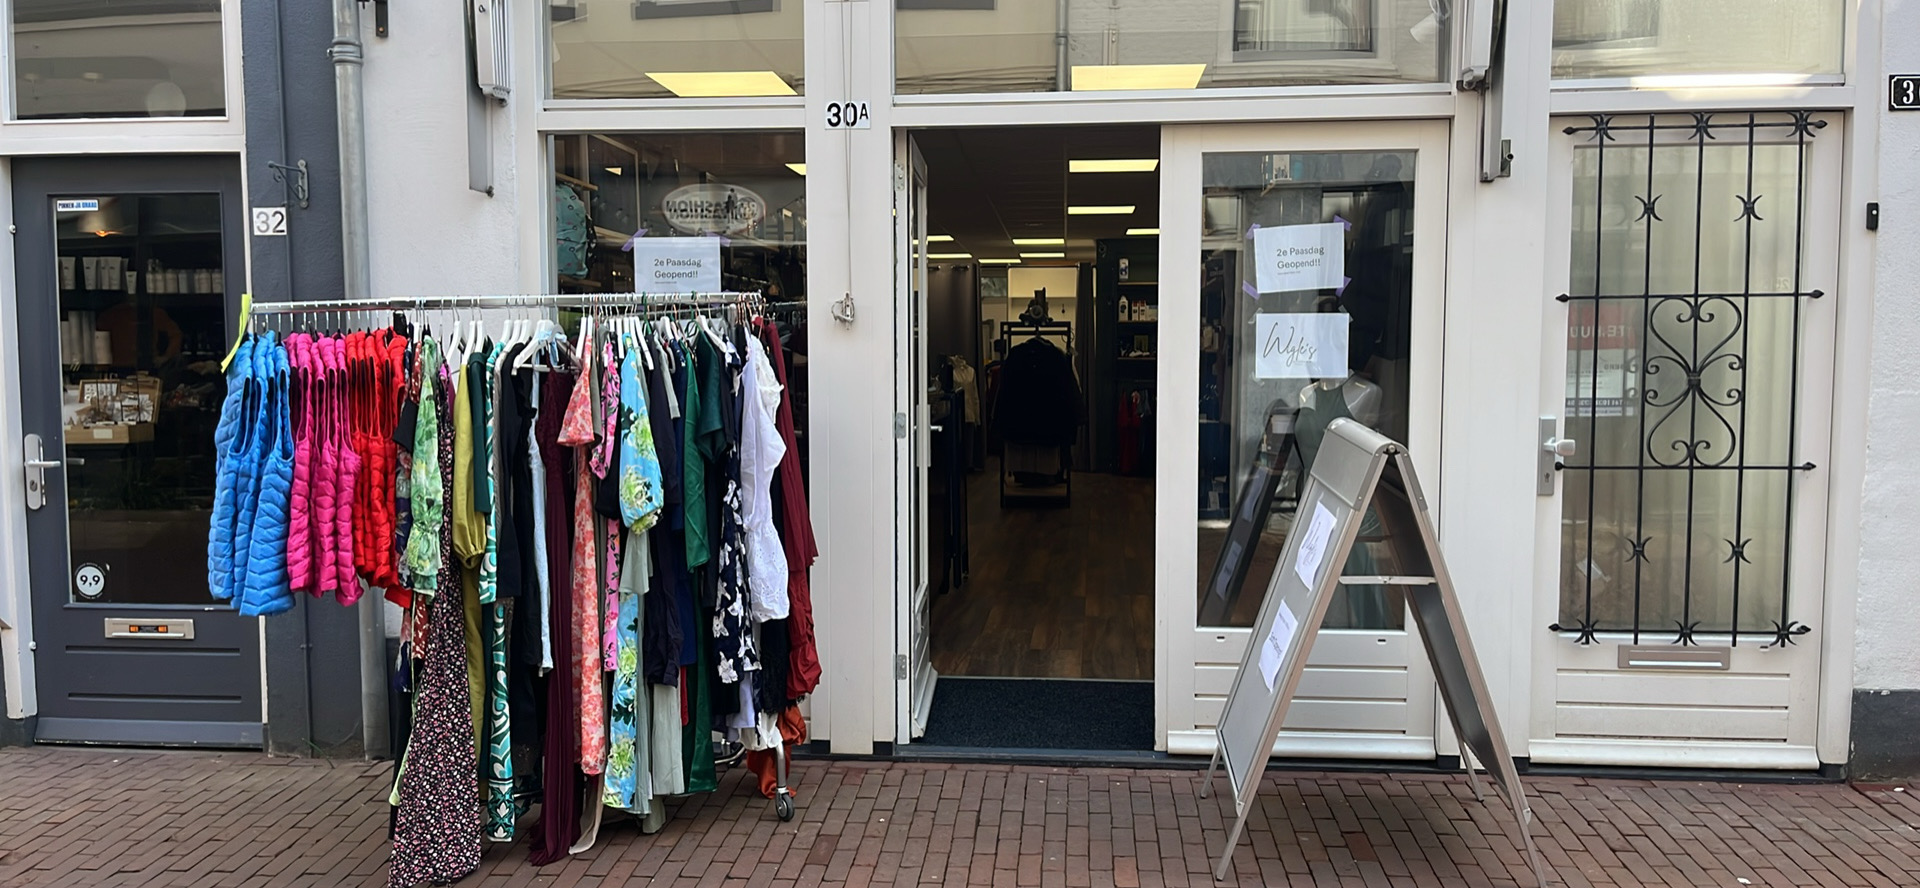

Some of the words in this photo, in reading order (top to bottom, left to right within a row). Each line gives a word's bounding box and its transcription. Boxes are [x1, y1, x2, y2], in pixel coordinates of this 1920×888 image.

[827, 102, 869, 127] 30A
[256, 211, 285, 233] 32
[1276, 248, 1287, 257] 2e
[1289, 246, 1325, 256] Paasdag
[654, 258, 665, 267] 2e
[666, 258, 702, 268] Paasdag
[1277, 258, 1321, 269] Geopend!!
[654, 270, 698, 279] Geopend!!
[80, 575, 101, 587] 9,9
